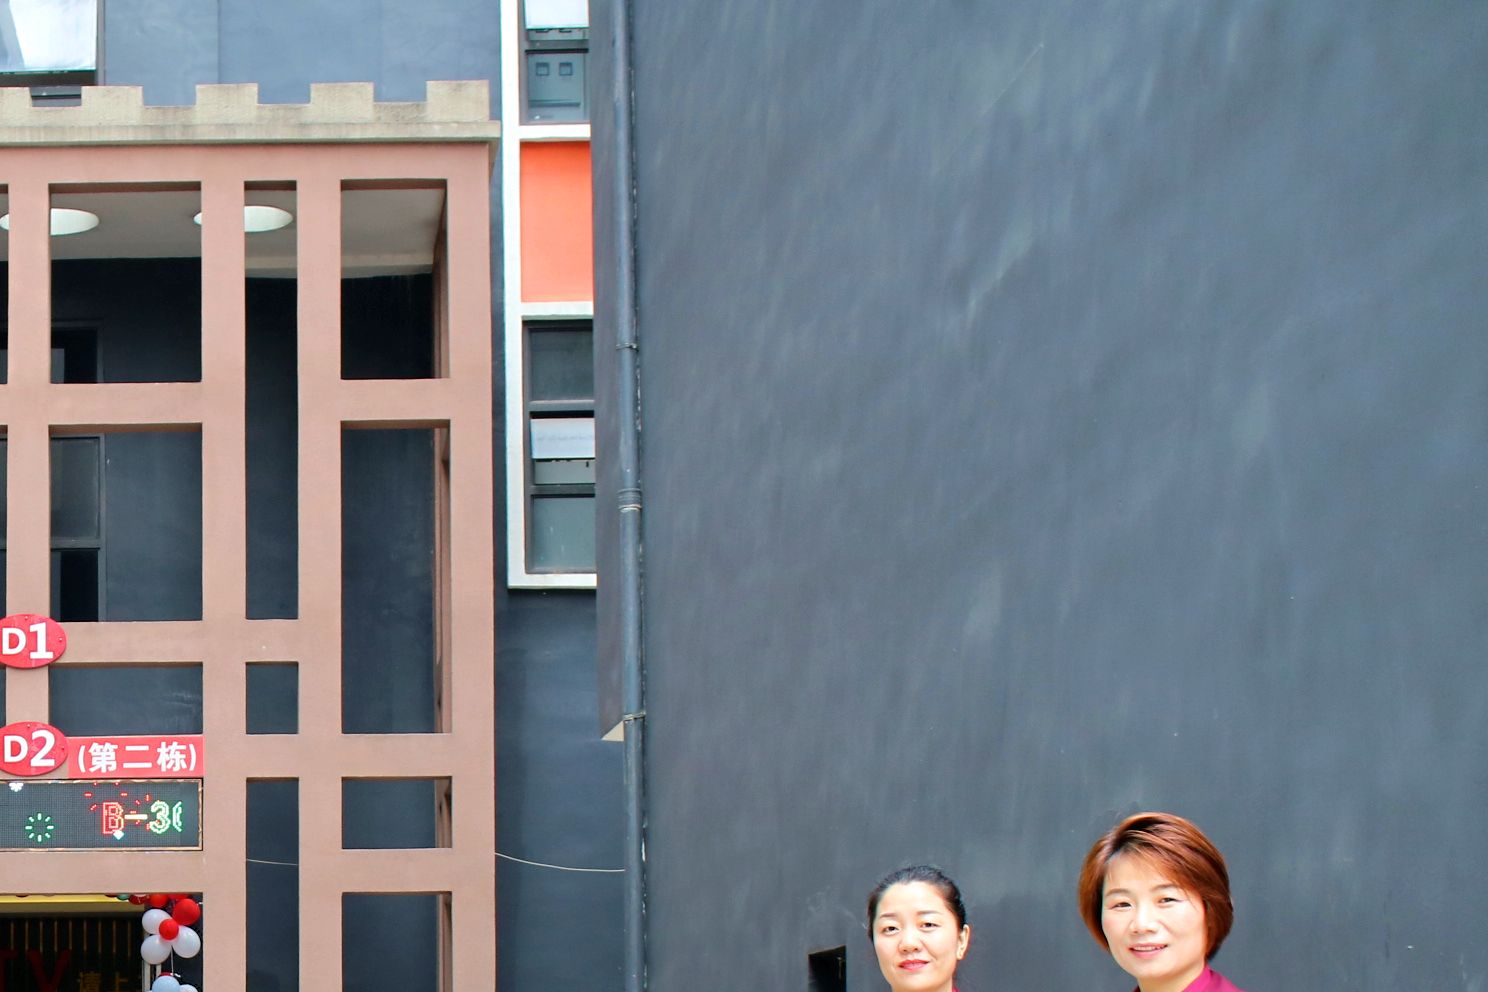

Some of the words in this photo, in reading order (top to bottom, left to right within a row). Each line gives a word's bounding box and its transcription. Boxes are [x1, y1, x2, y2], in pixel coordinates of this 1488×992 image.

[1, 622, 54, 659] D1
[3, 730, 55, 767] D2
[78, 741, 197, 773] (第二栋)
